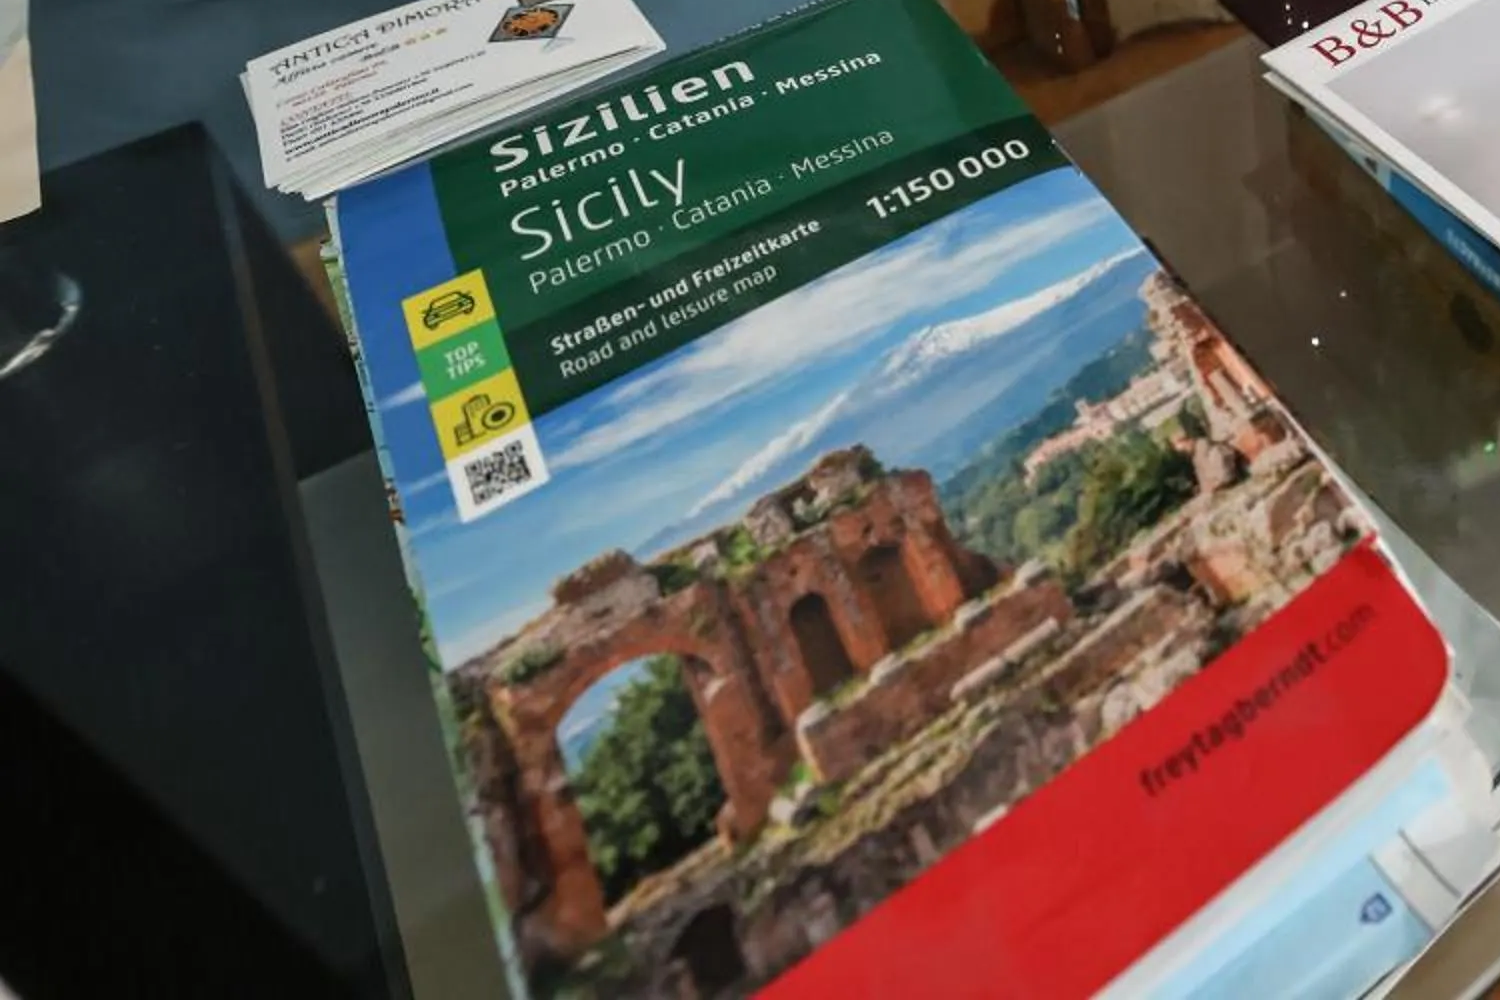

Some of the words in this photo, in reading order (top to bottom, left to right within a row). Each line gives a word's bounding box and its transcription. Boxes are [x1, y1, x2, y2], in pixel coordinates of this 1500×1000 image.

[271, 28, 371, 75] ANTICA
[489, 59, 755, 174] Sizilien
[499, 139, 626, 198] Palermo
[648, 92, 756, 142] Catania
[776, 50, 882, 96] Messina
[511, 159, 692, 261] Sicily
[528, 227, 651, 296] Palermo
[672, 175, 773, 231] Catania
[791, 126, 895, 180] Messina
[550, 298, 646, 356] Straßen-
[649, 278, 689, 312] und
[692, 219, 821, 287] Freizeitkarte
[558, 344, 611, 380] Road
[618, 323, 657, 352] and
[661, 288, 729, 331] leisure
[733, 265, 779, 297] map
[444, 341, 481, 366] TOP
[445, 353, 488, 380] TIPS
[1140, 602, 1377, 797] freytagberndt.com
